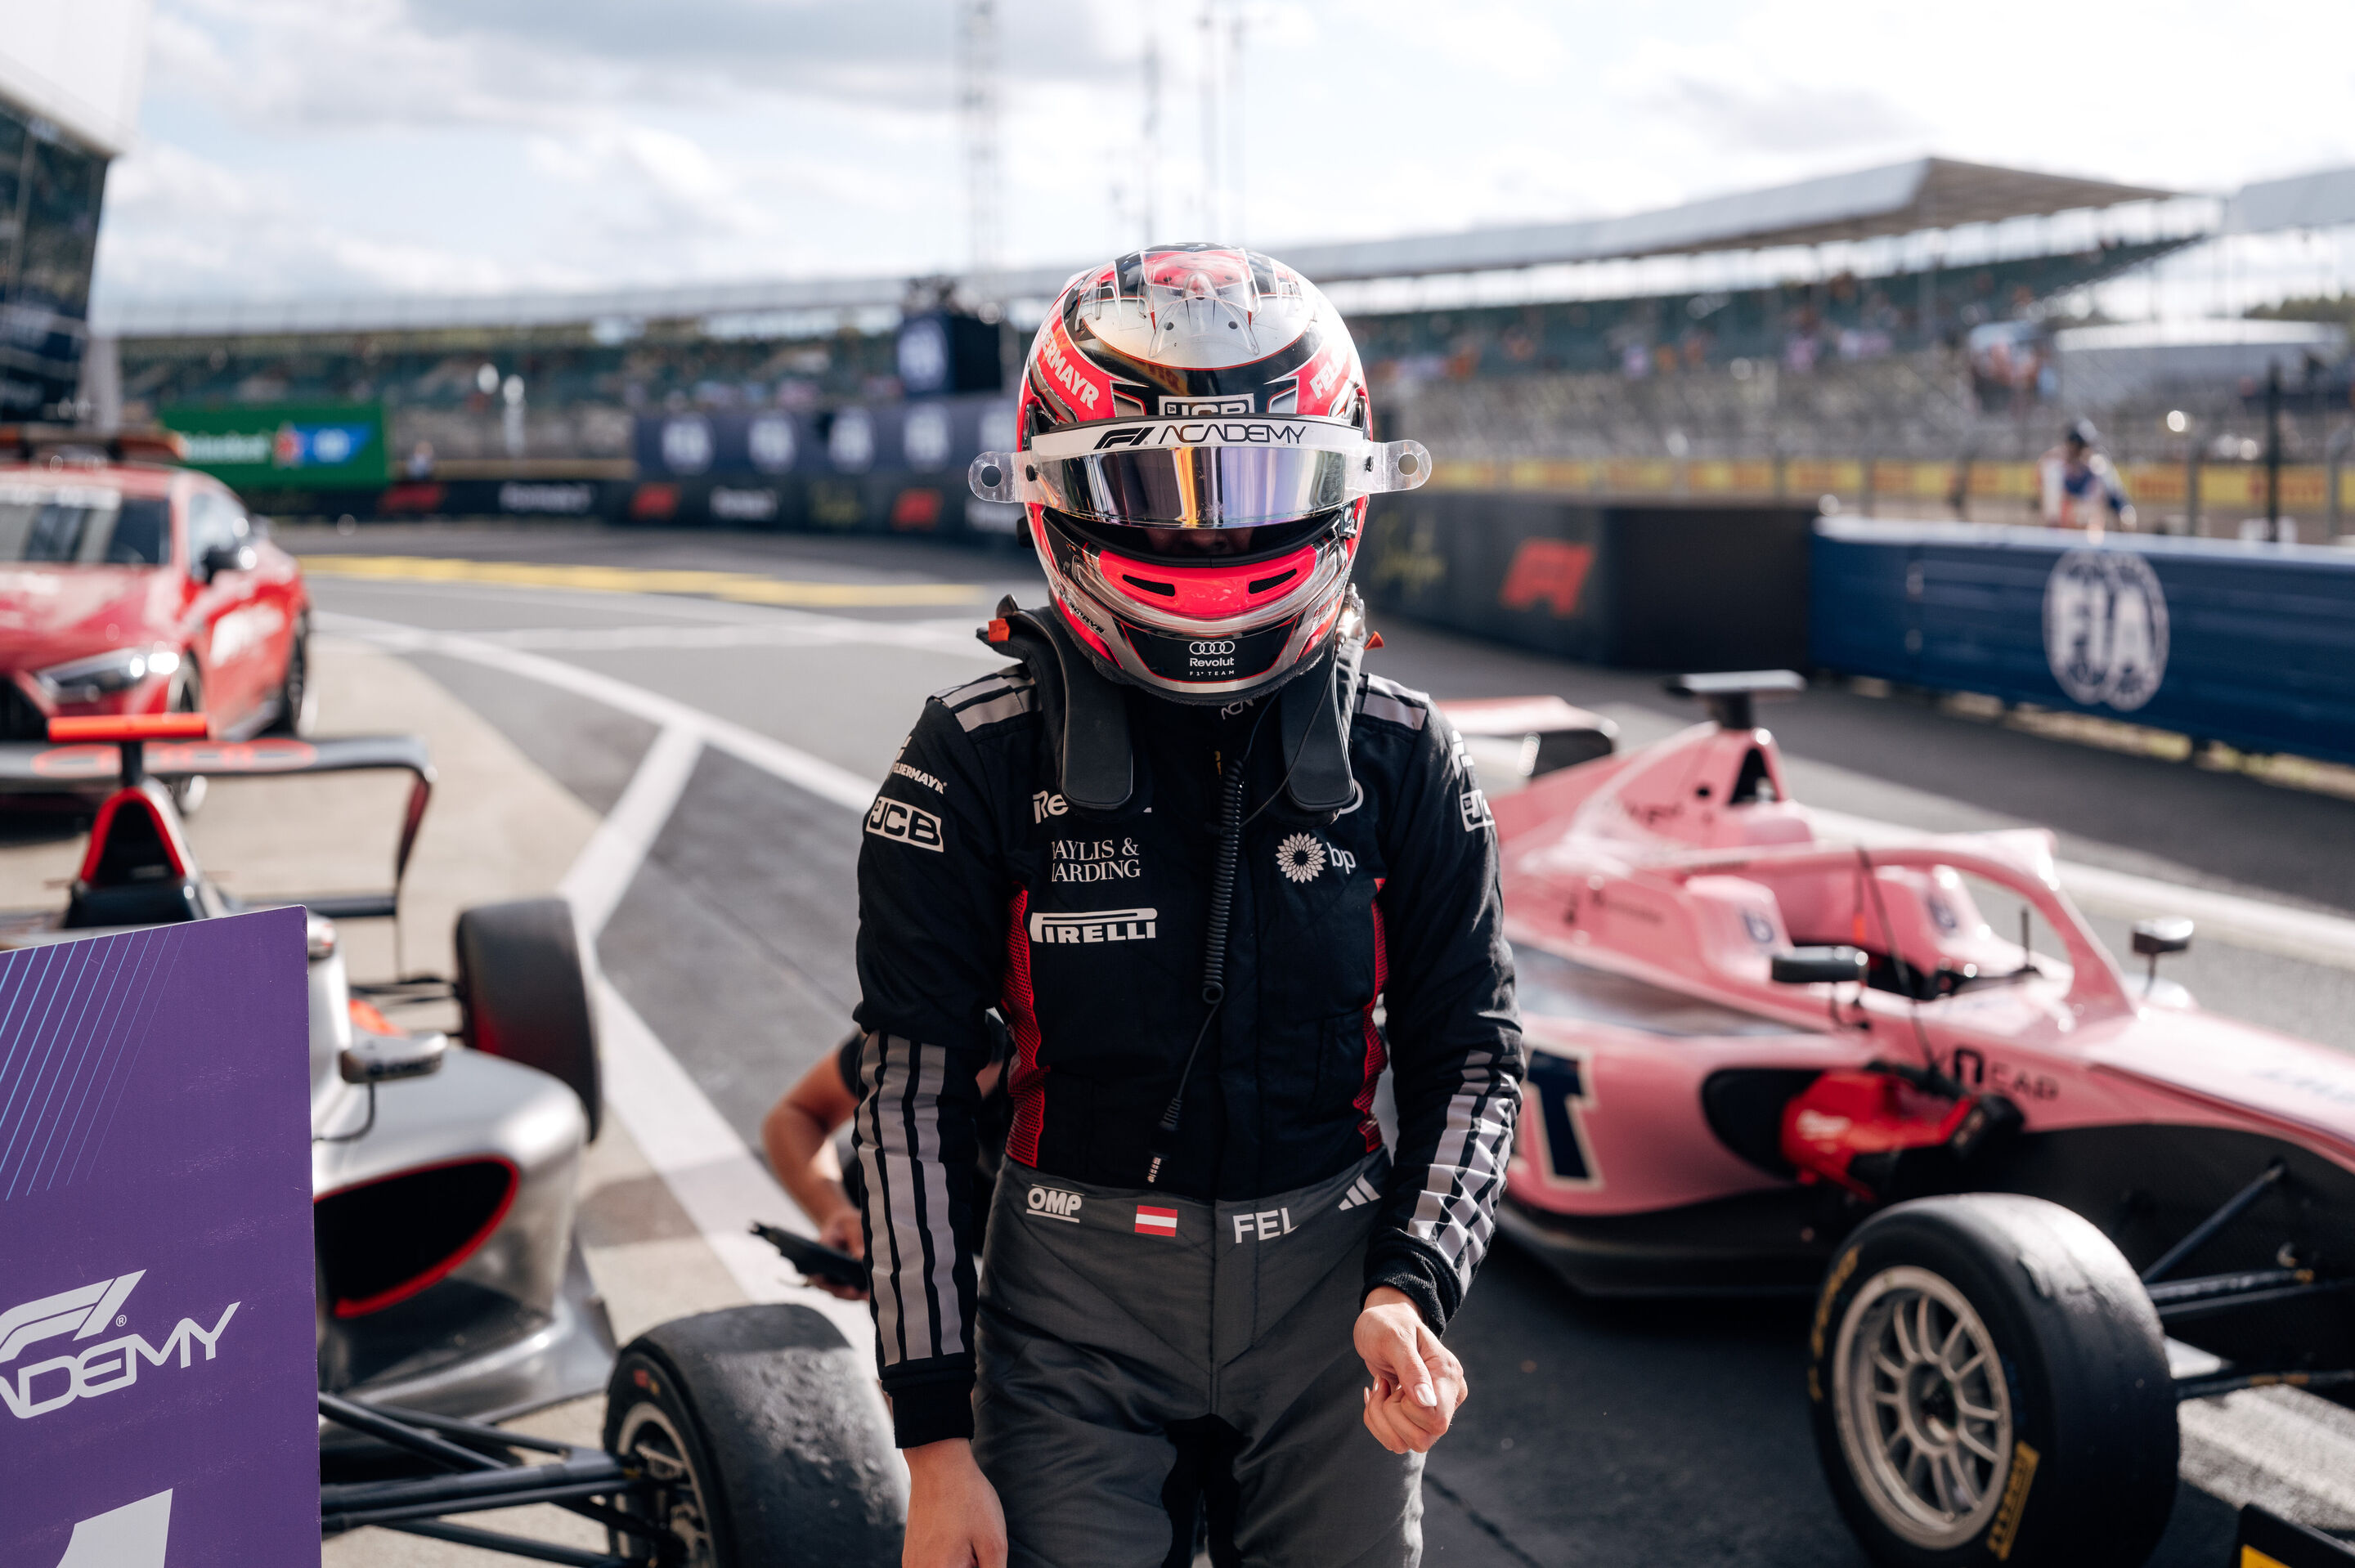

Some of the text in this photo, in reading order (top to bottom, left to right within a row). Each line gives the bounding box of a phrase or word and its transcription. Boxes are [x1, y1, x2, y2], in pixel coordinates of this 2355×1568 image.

[1158, 423, 1307, 444] ACADEMY
[1189, 656, 1235, 667] Revolut
[868, 800, 941, 847] JCB
[1051, 837, 1140, 861] AYLIS &
[1326, 841, 1357, 875] bp
[1051, 858, 1142, 882] ARDING
[1029, 907, 1158, 943] PIRELLI
[1026, 1186, 1082, 1216] OMP
